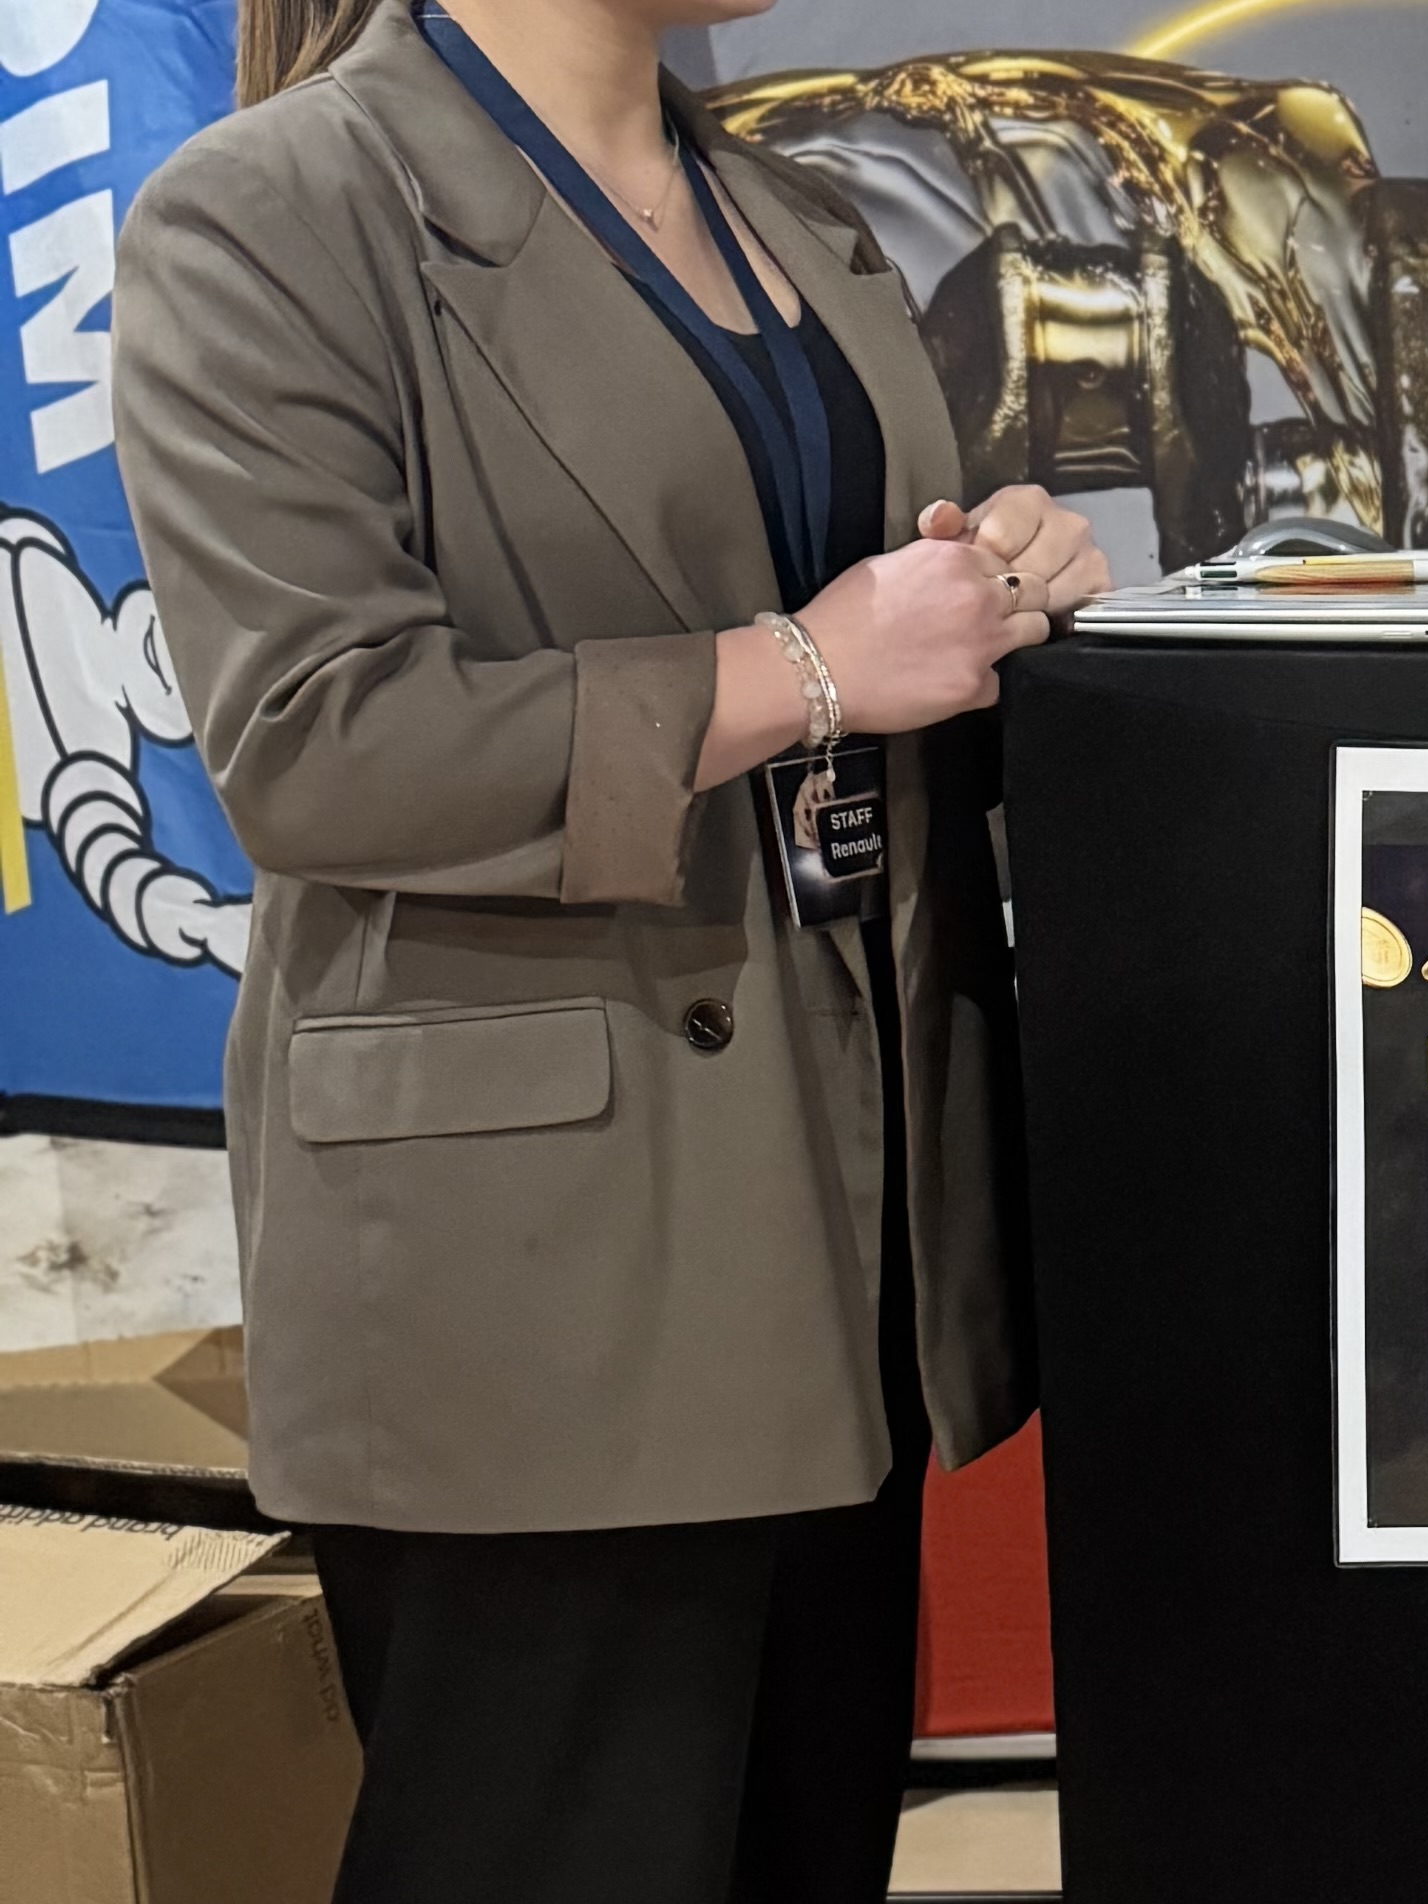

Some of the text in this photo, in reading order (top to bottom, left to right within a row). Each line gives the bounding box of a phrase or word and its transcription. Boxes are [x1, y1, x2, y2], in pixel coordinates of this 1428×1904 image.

[830, 806, 874, 831] STAFF
[830, 832, 883, 860] Renault
[82, 1514, 186, 1542] brand
